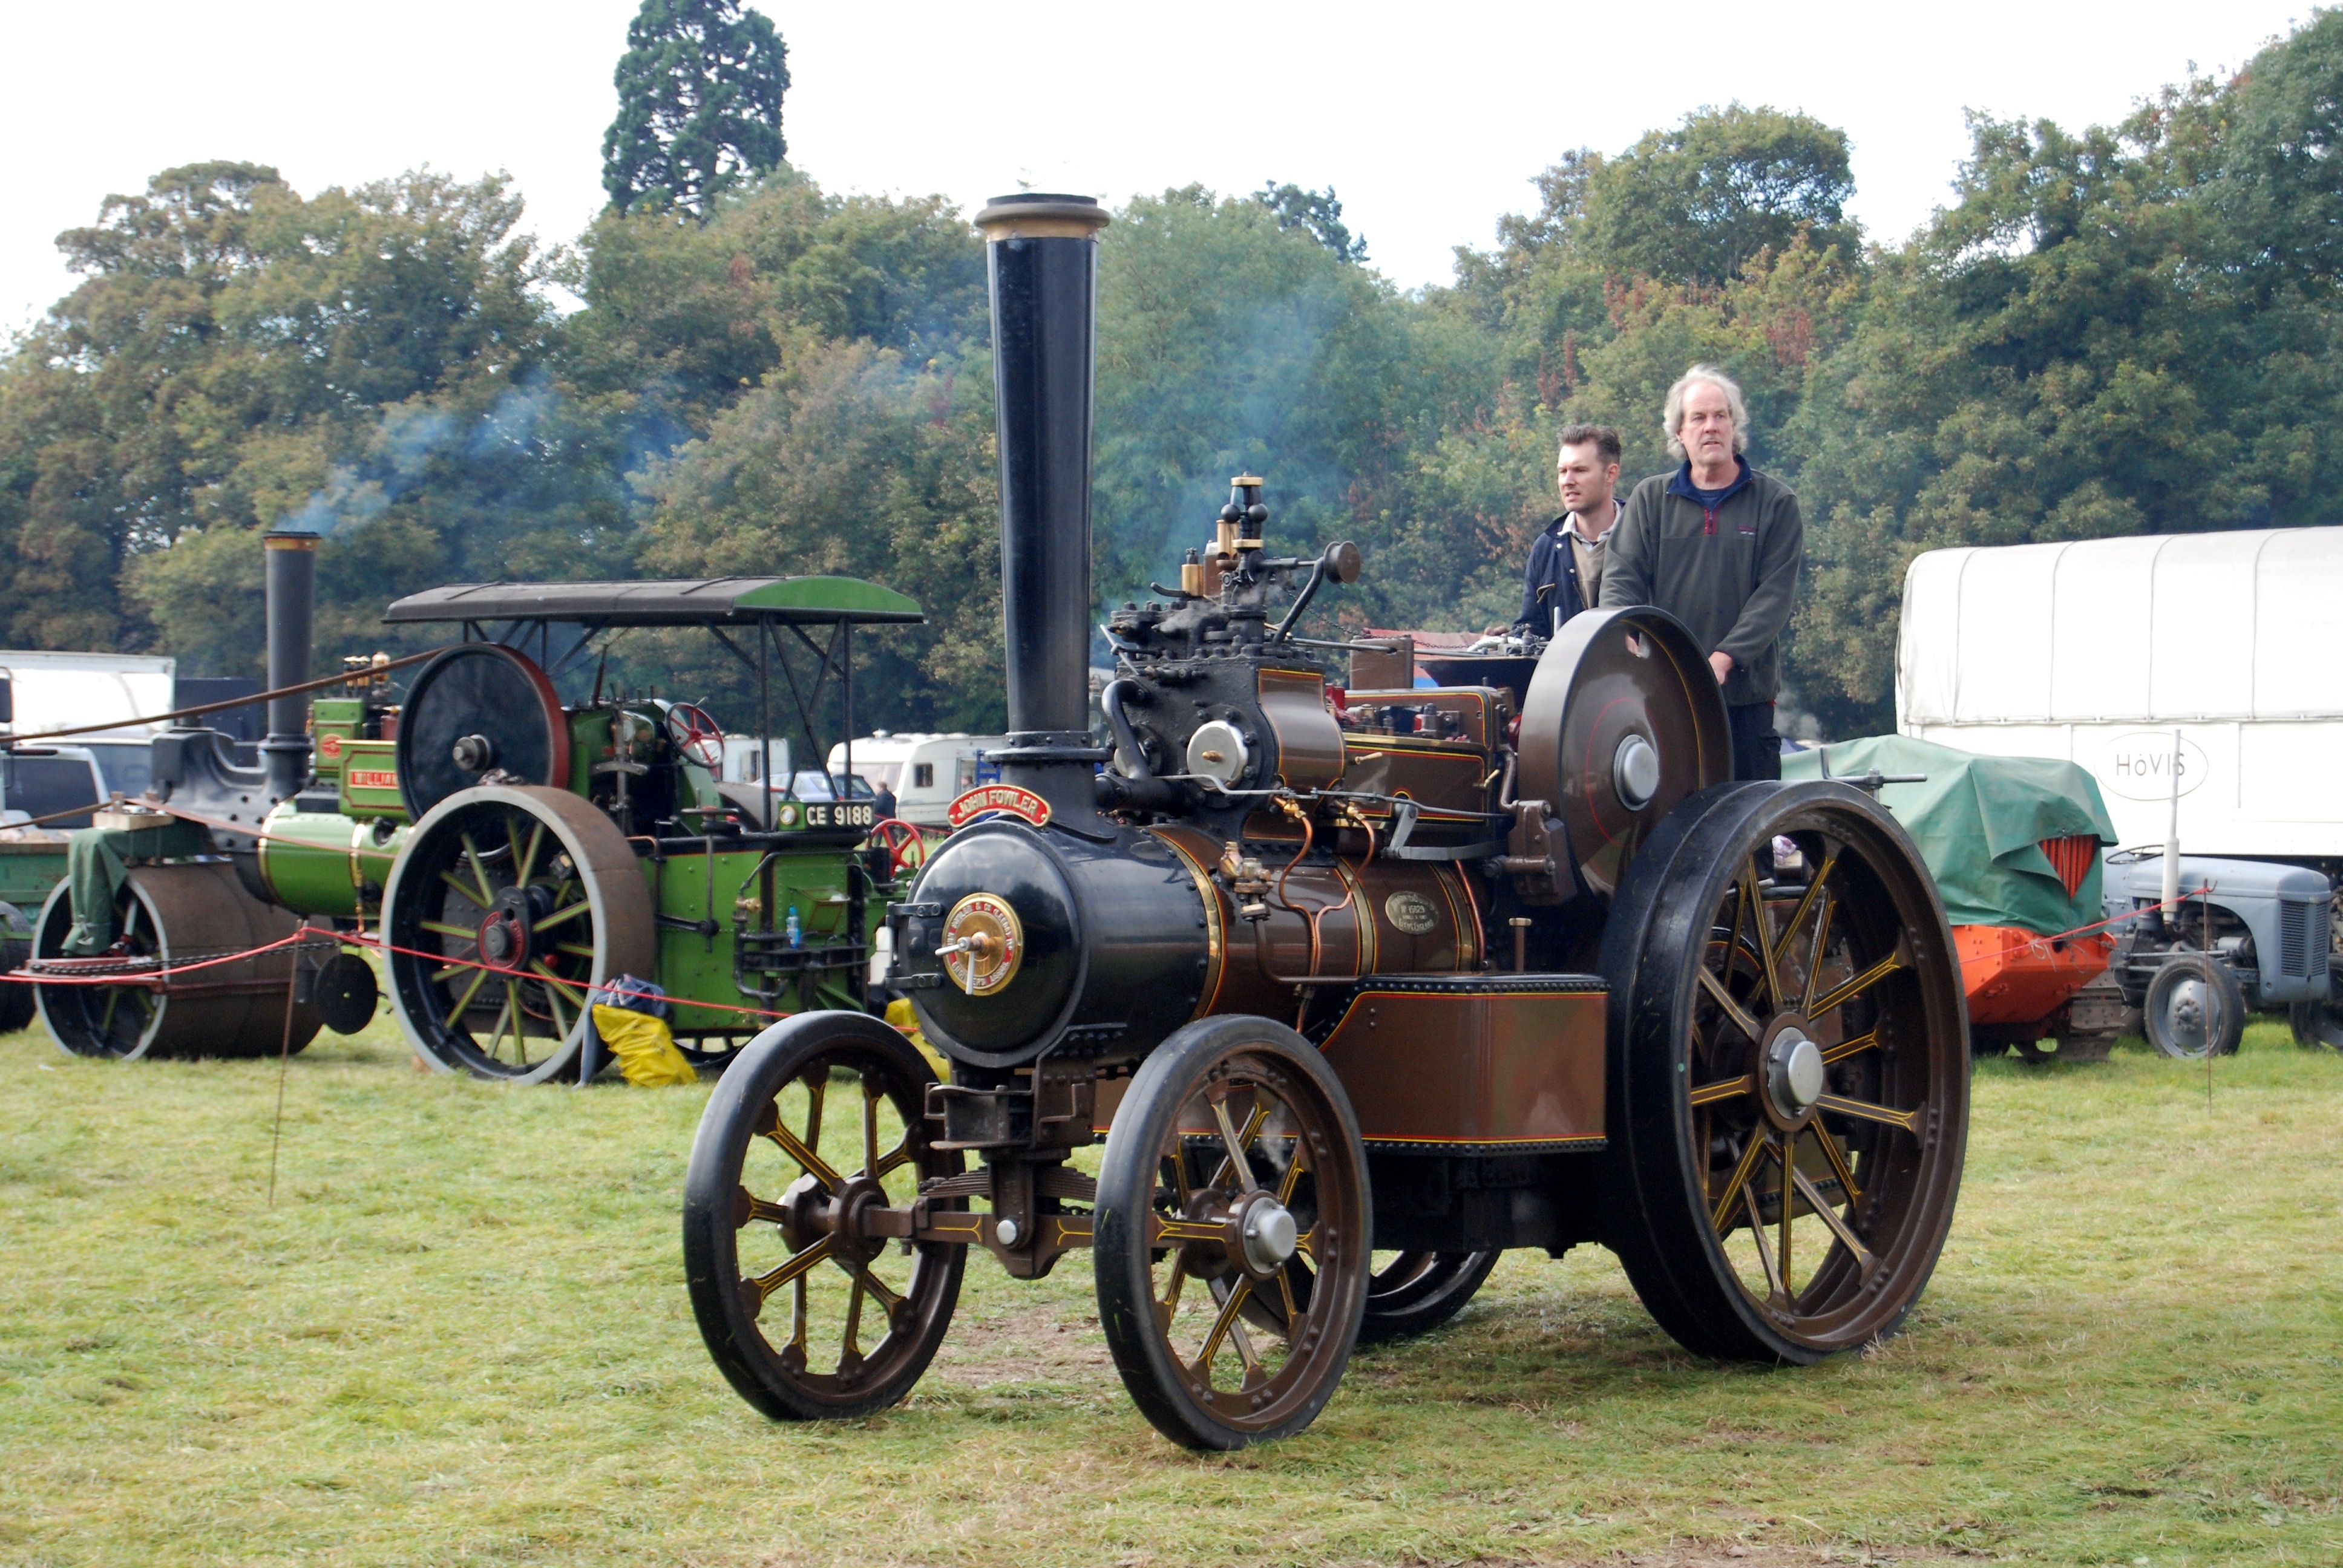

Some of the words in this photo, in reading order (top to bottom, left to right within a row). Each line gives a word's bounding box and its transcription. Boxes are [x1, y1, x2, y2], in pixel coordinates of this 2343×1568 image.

[807, 806, 826, 826] CE
[834, 805, 872, 825] 9188
[957, 791, 987, 818] JOHN
[989, 789, 1038, 815] FOWLER
